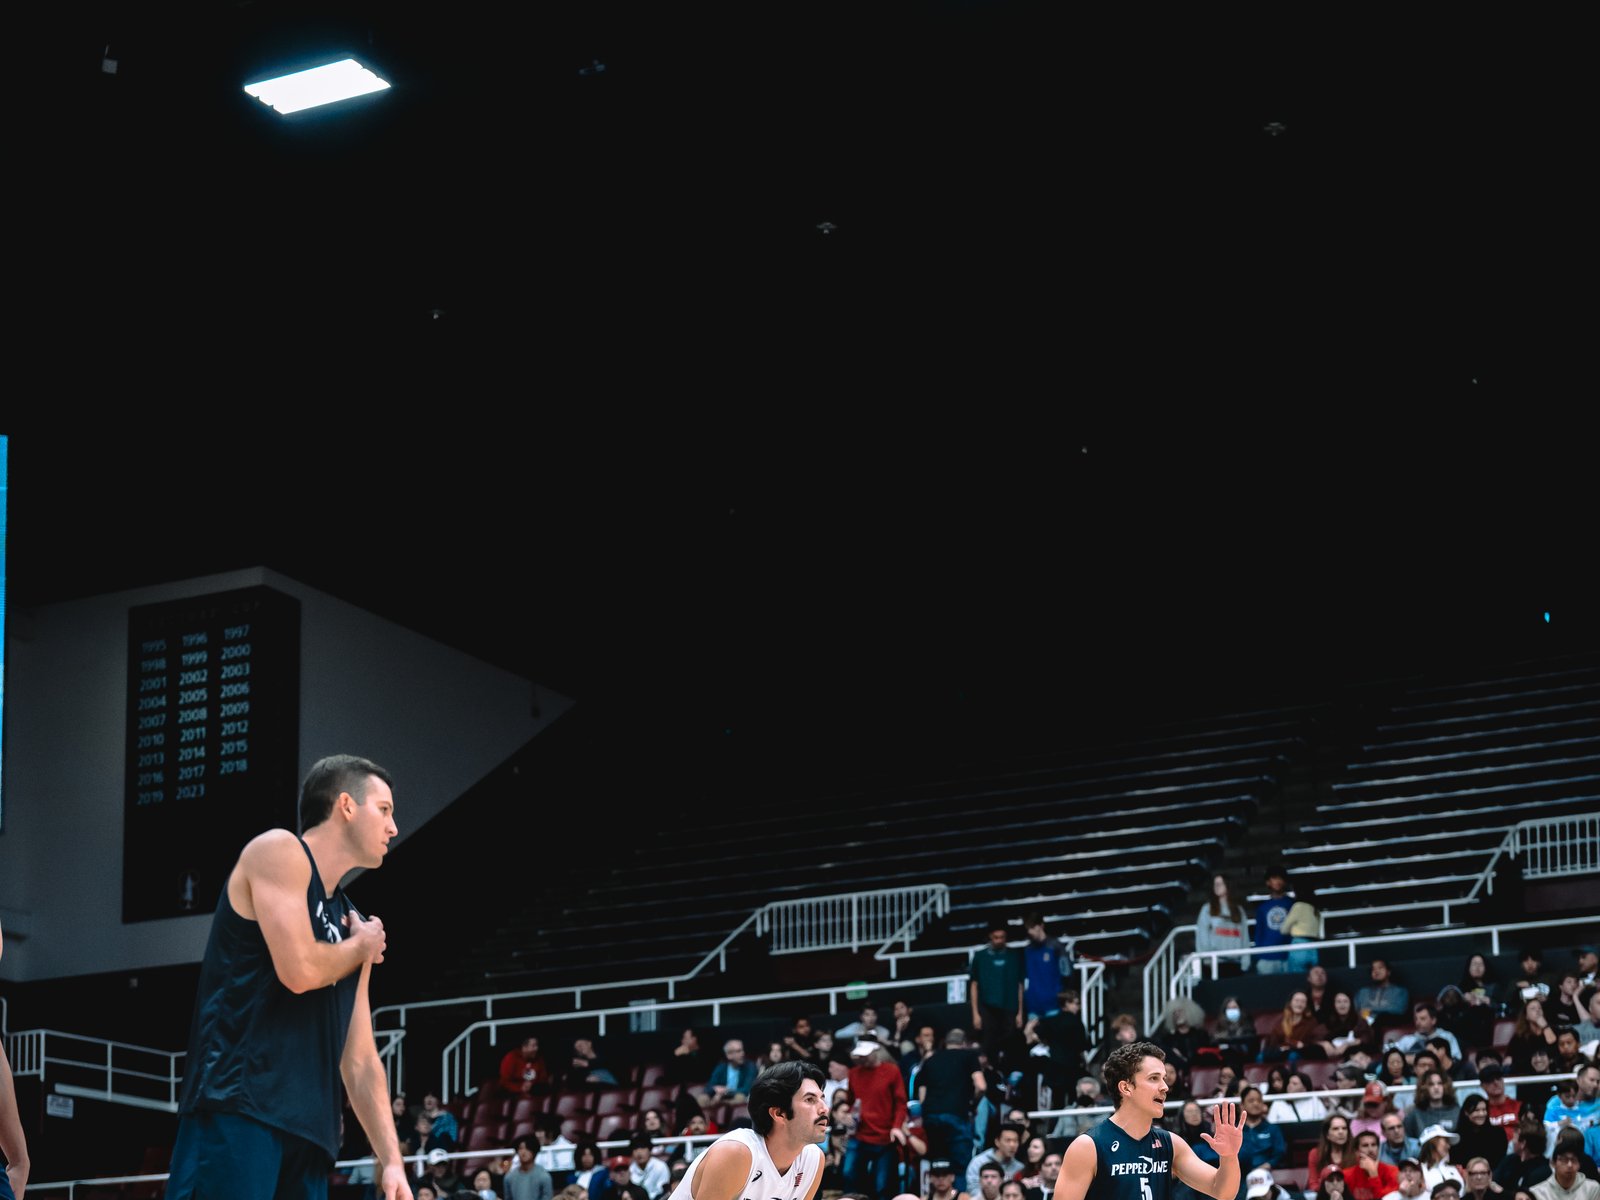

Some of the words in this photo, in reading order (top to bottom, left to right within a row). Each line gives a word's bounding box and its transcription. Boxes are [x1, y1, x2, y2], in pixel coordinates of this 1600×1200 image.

[182, 632, 208, 646] 1996
[223, 624, 250, 640] 1997
[181, 650, 208, 665] 1999
[220, 643, 251, 661] 2000
[139, 675, 167, 692] 2001
[179, 668, 208, 686] 2002
[220, 662, 250, 680] 2003
[138, 695, 167, 710] 2004
[178, 687, 208, 705] 2005
[220, 681, 250, 699] 2006
[138, 713, 167, 729] 2007
[177, 707, 208, 724] 2008
[219, 701, 250, 718] 2009
[138, 732, 165, 748] 2010
[180, 726, 207, 743] 2011
[220, 719, 249, 737] 2012
[138, 751, 165, 767] 2013
[178, 745, 206, 762] 2014
[220, 739, 248, 756] 2015
[178, 764, 206, 781] 2017
[219, 758, 248, 775] 2018
[175, 783, 206, 801] 2023
[1111, 1156, 1168, 1176] PEPPERDINE
